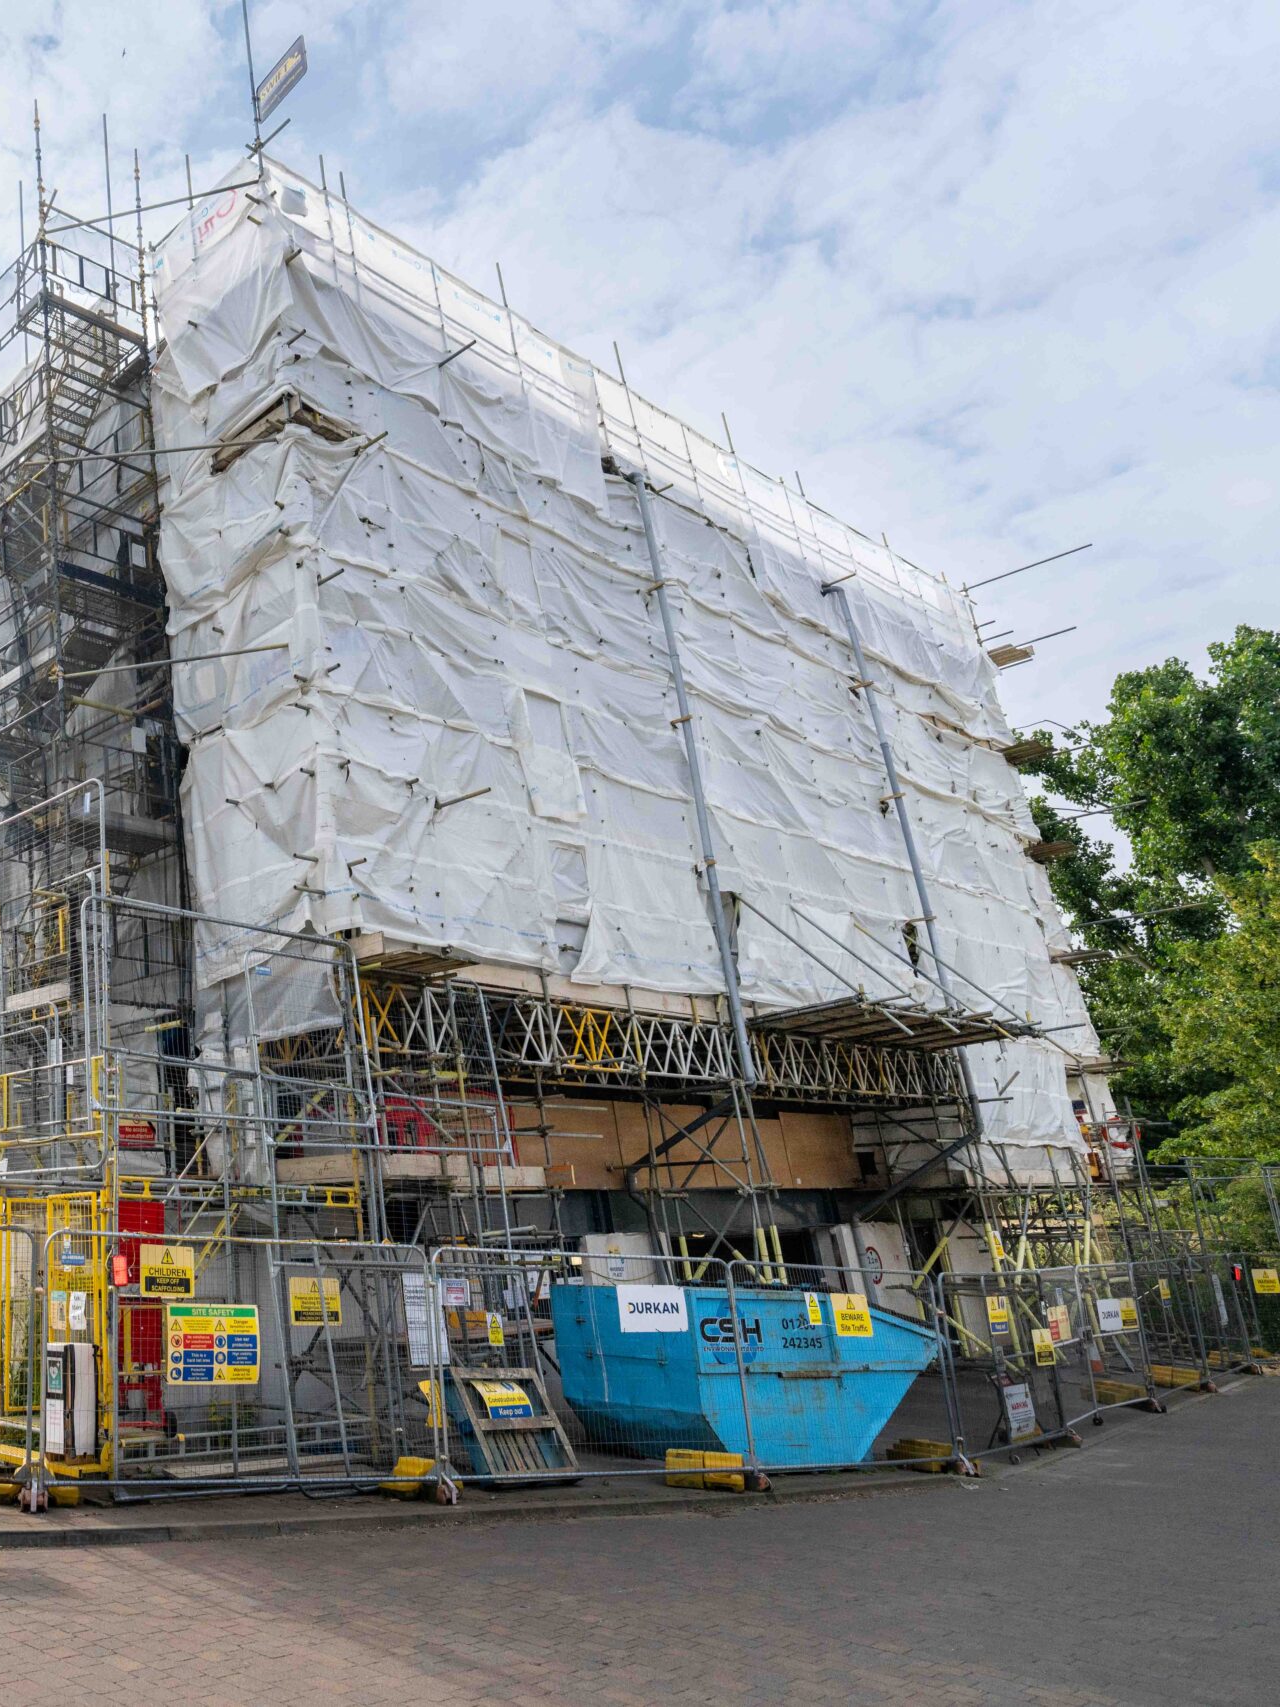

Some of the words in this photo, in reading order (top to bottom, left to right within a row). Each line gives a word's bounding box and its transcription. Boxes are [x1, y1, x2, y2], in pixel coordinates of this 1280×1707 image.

[149, 1267, 186, 1277] CHILDREN
[627, 1302, 679, 1314] DURKAN
[700, 1317, 763, 1343] CSH
[852, 1324, 868, 1332] Traffic
[782, 1337, 822, 1348] 242345
[499, 1408, 513, 1416] Keep
